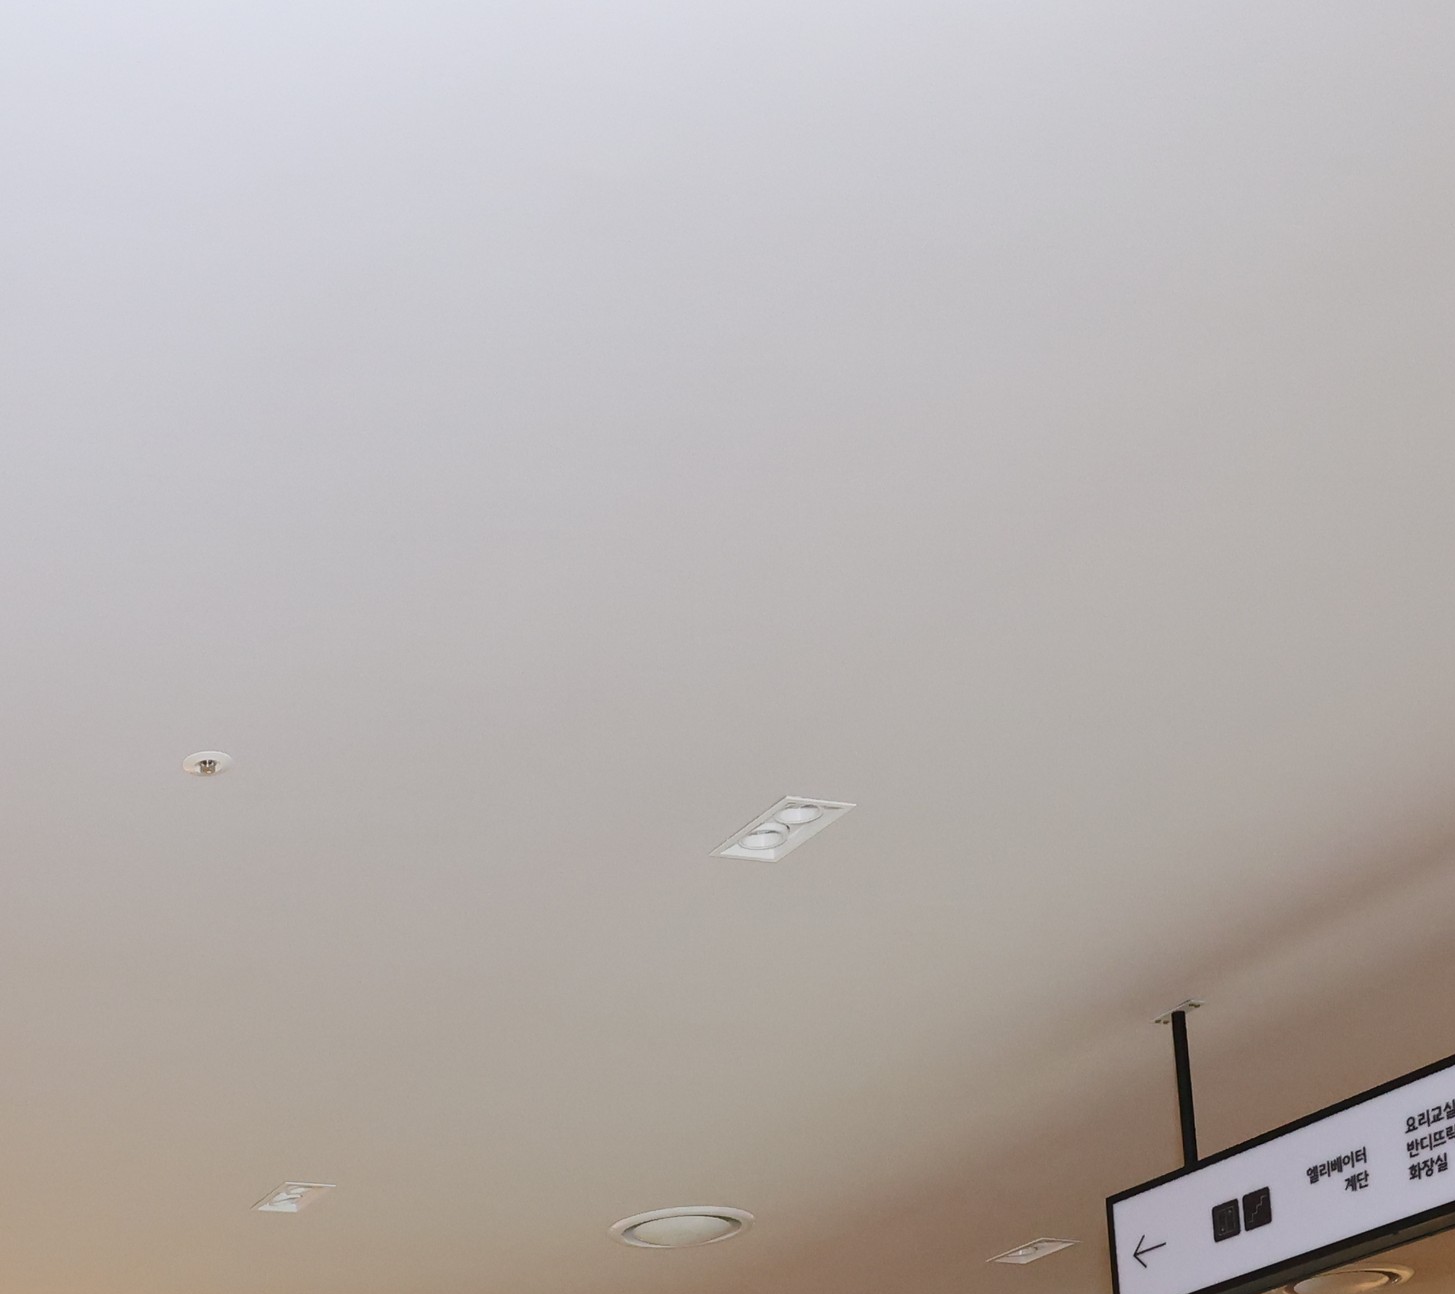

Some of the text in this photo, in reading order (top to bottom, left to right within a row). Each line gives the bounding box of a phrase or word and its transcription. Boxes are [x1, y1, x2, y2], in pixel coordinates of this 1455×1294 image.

[1305, 1146, 1368, 1185] 엘리베이터
[1344, 1169, 1370, 1192] 계단
[1408, 1151, 1449, 1181] 화장실
